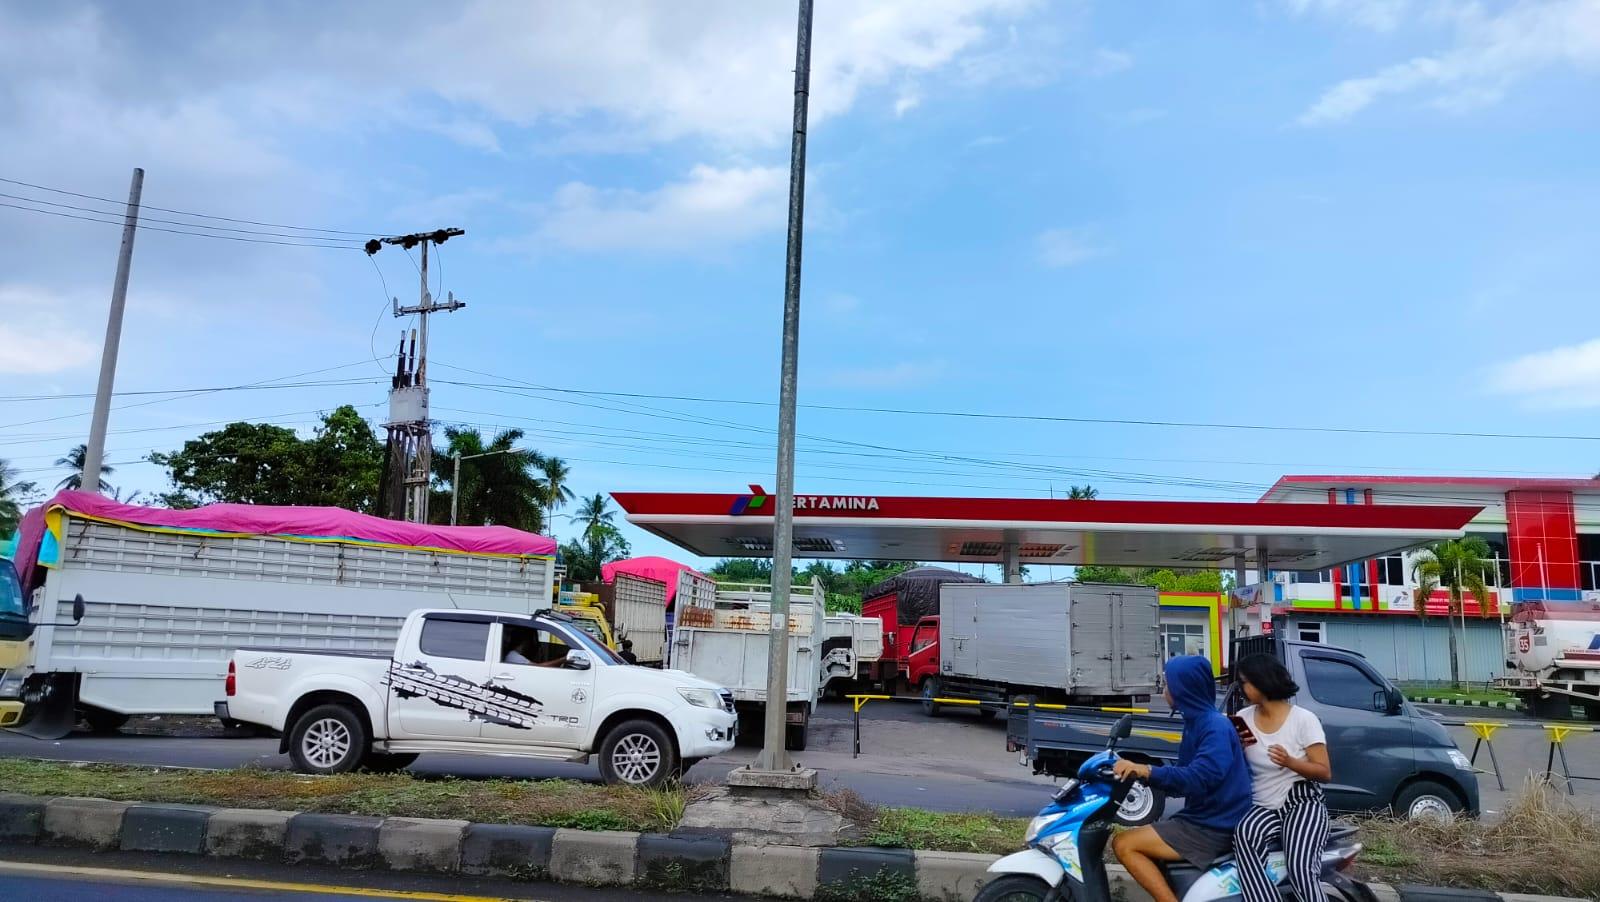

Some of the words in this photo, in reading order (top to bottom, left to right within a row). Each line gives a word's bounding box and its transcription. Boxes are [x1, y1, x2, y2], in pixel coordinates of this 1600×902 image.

[792, 496, 880, 510] ERTAMINA
[1519, 639, 1529, 652] 35
[549, 714, 579, 724] TRD
